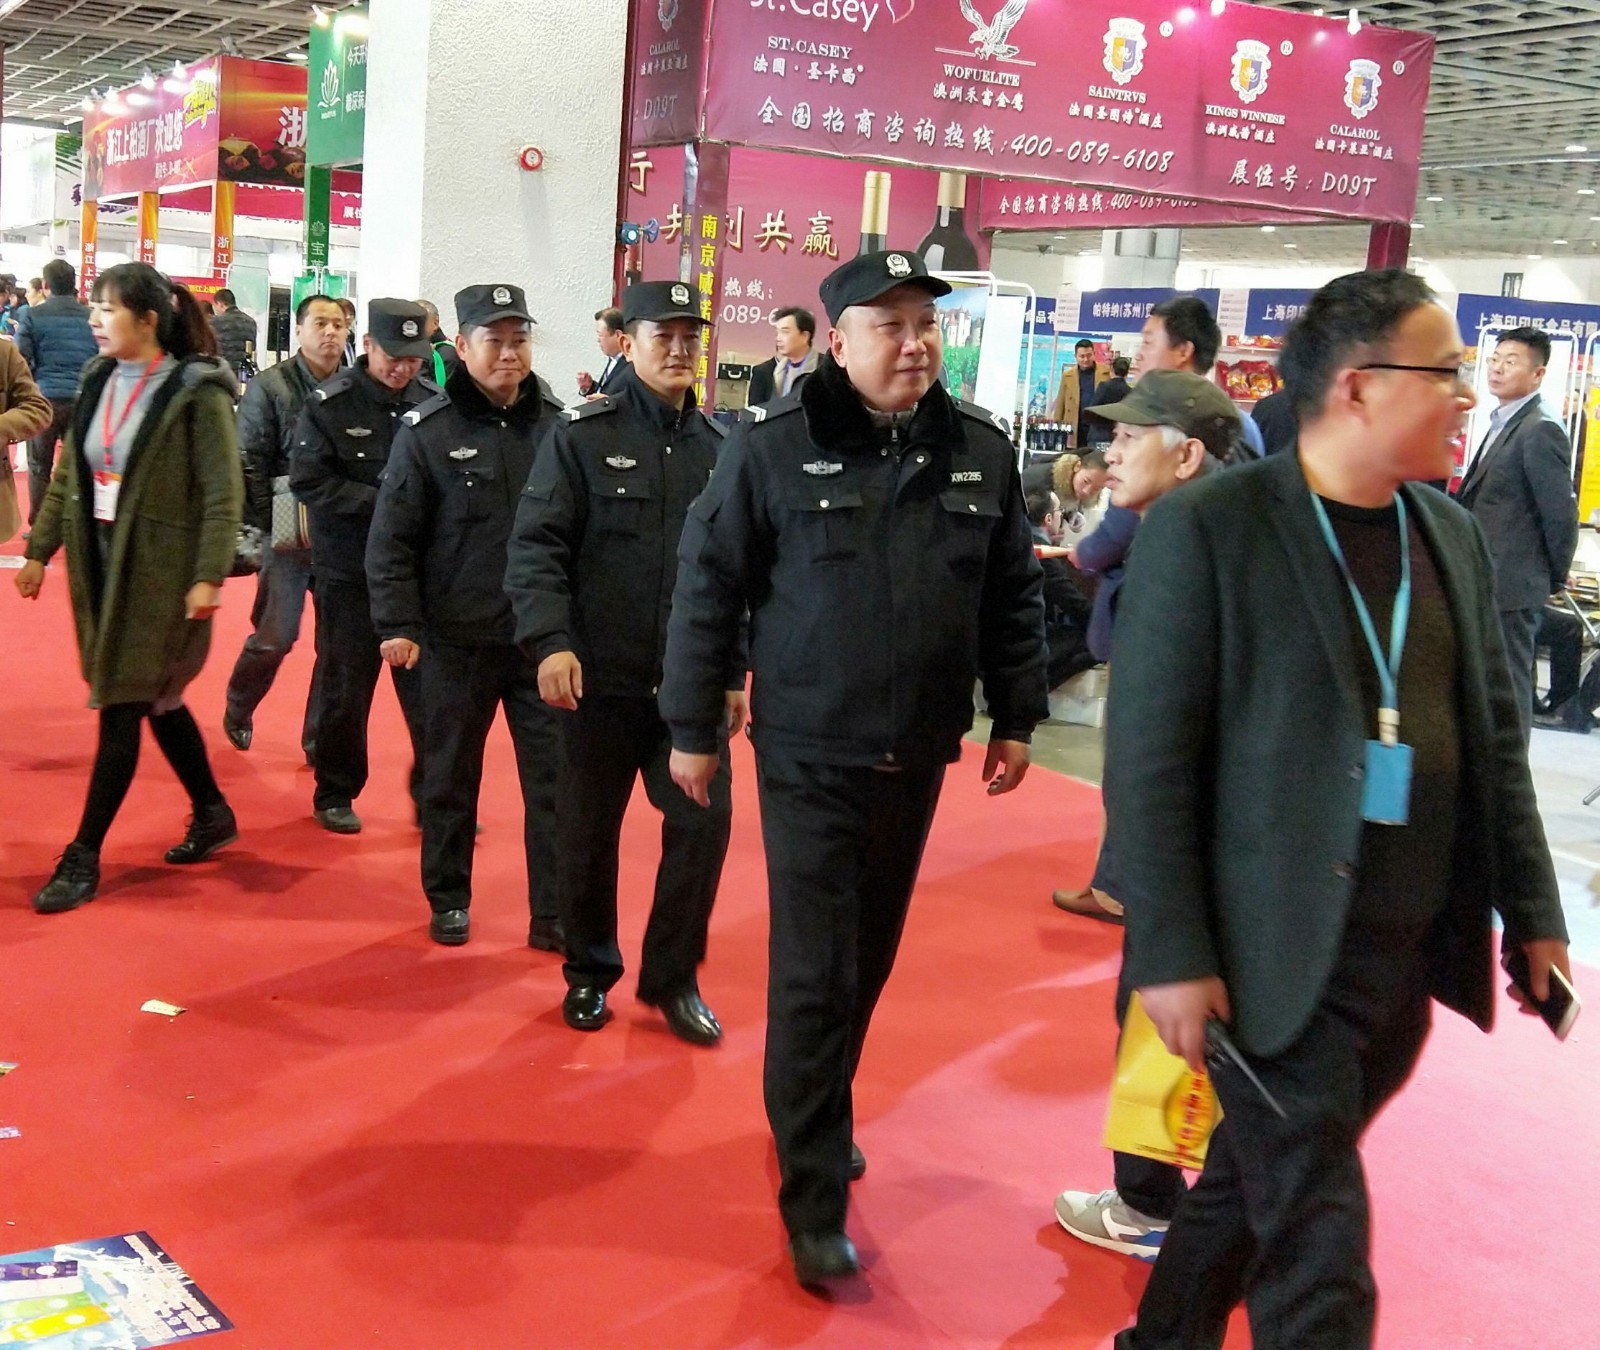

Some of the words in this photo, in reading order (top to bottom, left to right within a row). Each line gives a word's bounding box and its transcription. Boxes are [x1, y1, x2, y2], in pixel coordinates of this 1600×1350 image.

[750, 0, 879, 32] .Casey
[767, 35, 853, 59] ST.CASEY
[943, 63, 1021, 87] WOFUELITE
[1088, 85, 1147, 104] SAINTRVS
[1205, 104, 1238, 119] KINGS
[1239, 108, 1286, 125] WINNESE
[1330, 124, 1380, 141] CALAROL
